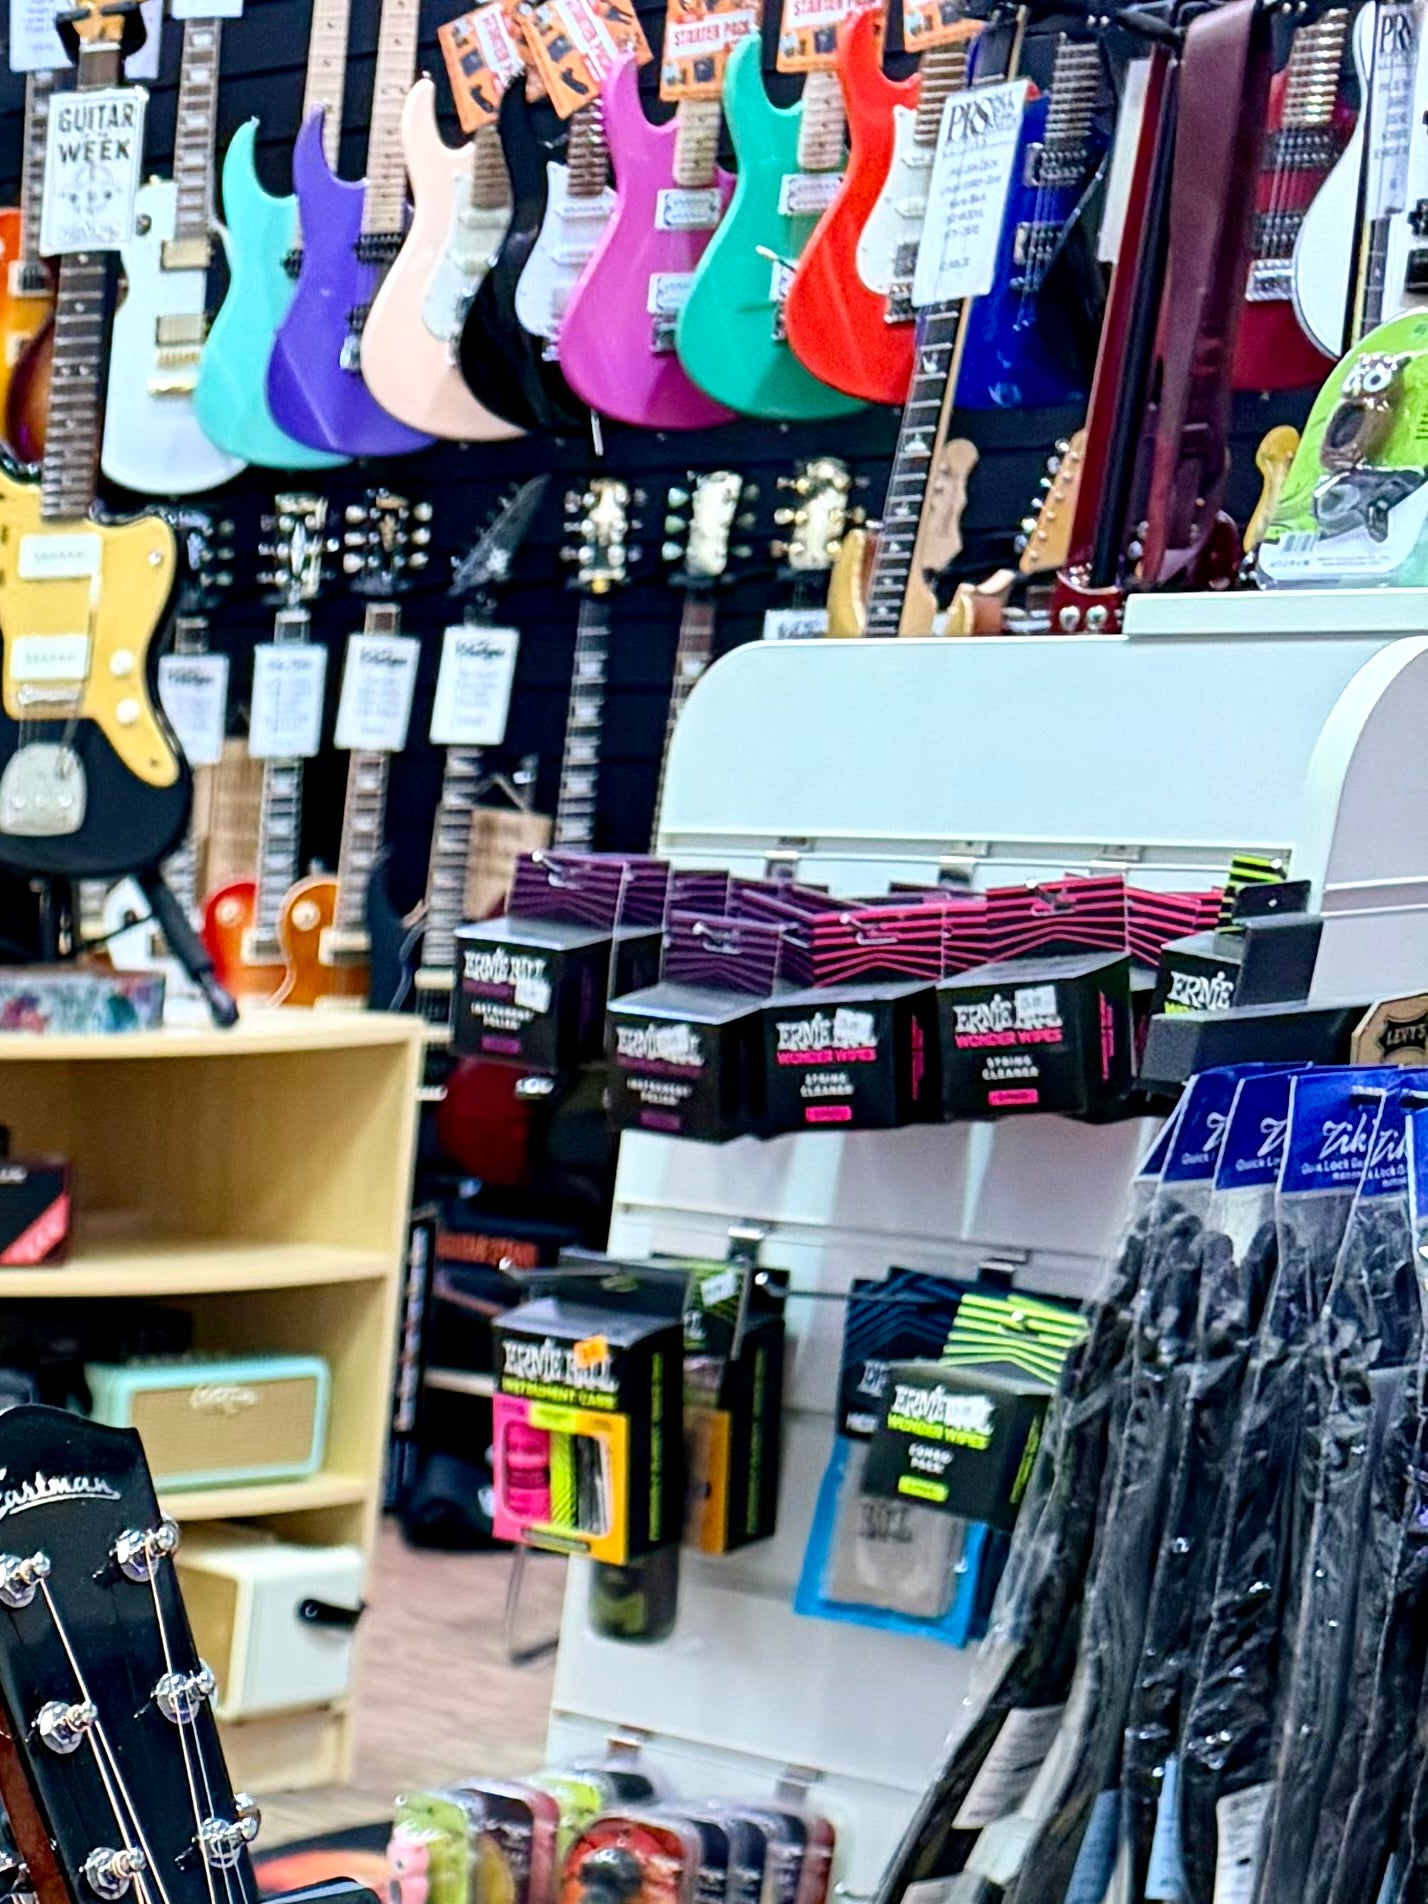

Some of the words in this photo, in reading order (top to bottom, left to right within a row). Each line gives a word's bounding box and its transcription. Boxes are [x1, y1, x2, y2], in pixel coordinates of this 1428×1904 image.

[58, 103, 135, 132] GUITAR
[57, 137, 131, 163] WEEK
[1166, 970, 1235, 1011] ERNIE
[776, 1011, 833, 1052] ERNIE
[952, 993, 1014, 1034] ERNIE
